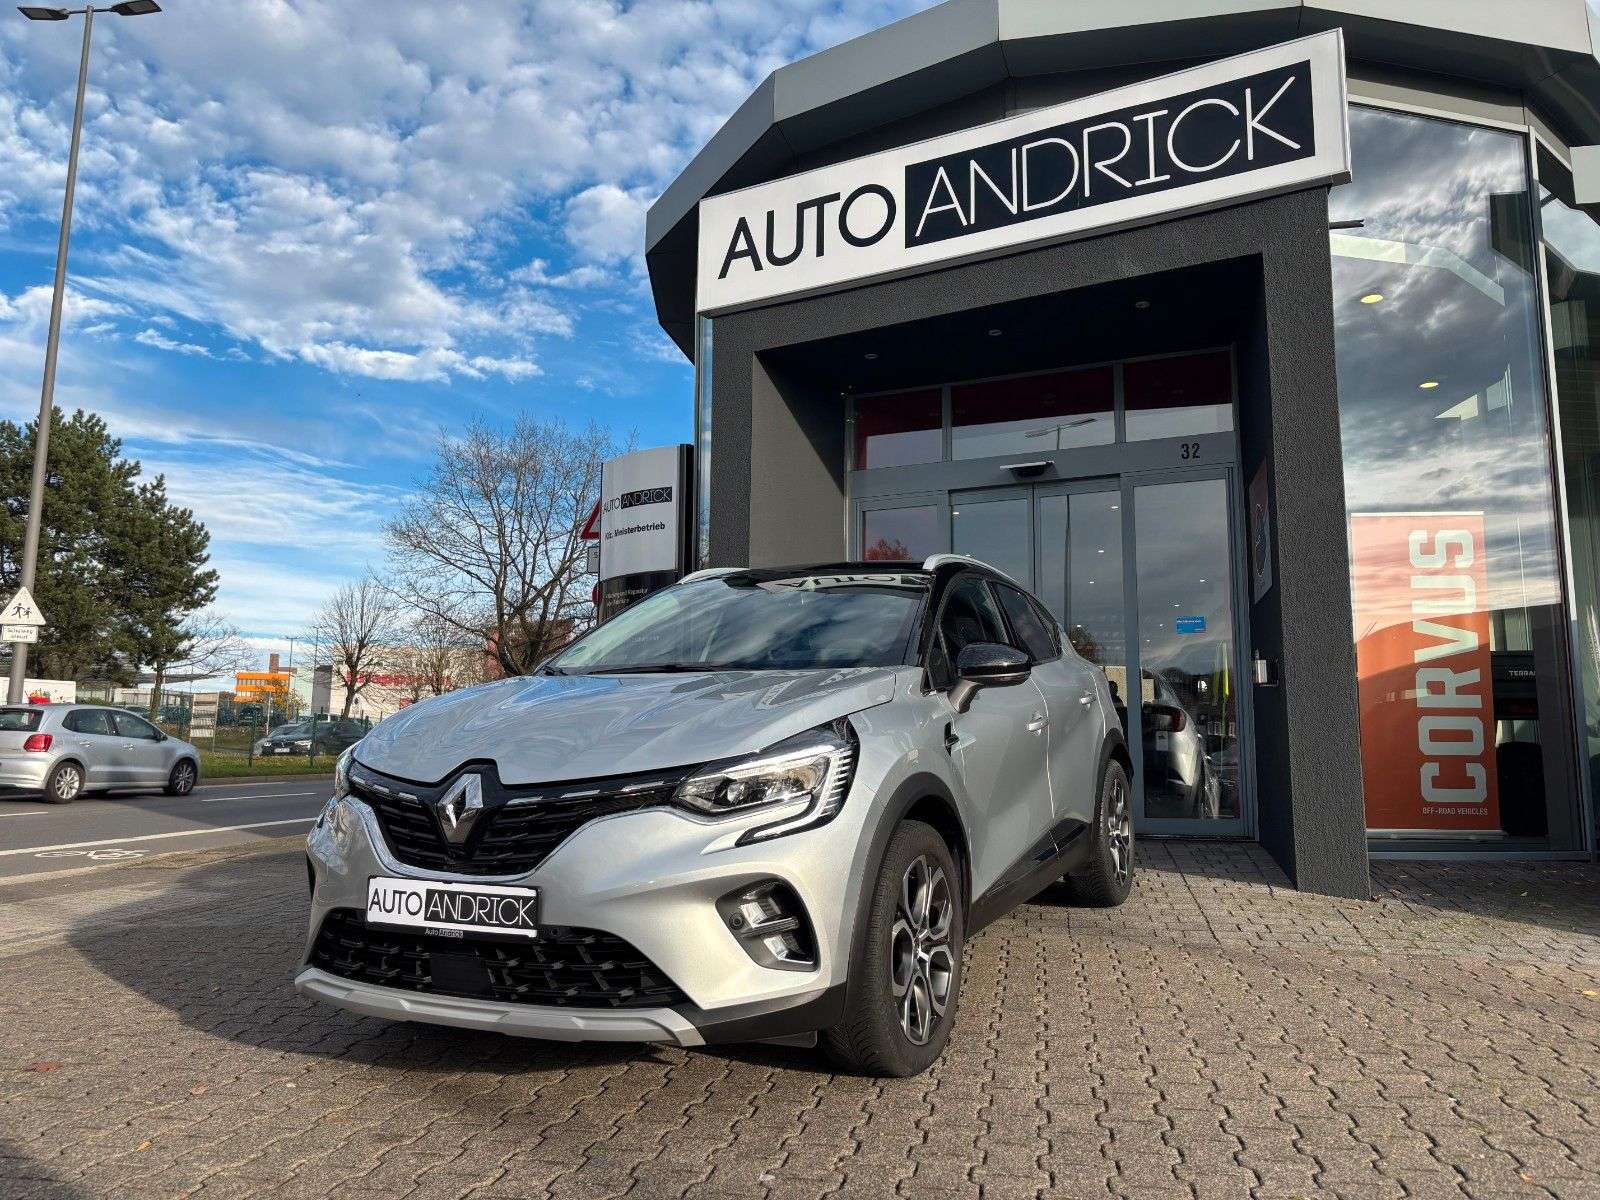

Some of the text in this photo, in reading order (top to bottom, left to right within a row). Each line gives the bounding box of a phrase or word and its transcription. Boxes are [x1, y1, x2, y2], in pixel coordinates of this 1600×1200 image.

[718, 76, 1300, 279] AUTO ANDRICK
[1181, 443, 1200, 459] 32
[603, 489, 671, 514] AUTO ANDRICK
[1408, 529, 1488, 803] CORVUS
[1422, 807, 1488, 816] OFF-ROAD VEHICLES
[369, 888, 534, 927] AUTO ANDRICK
